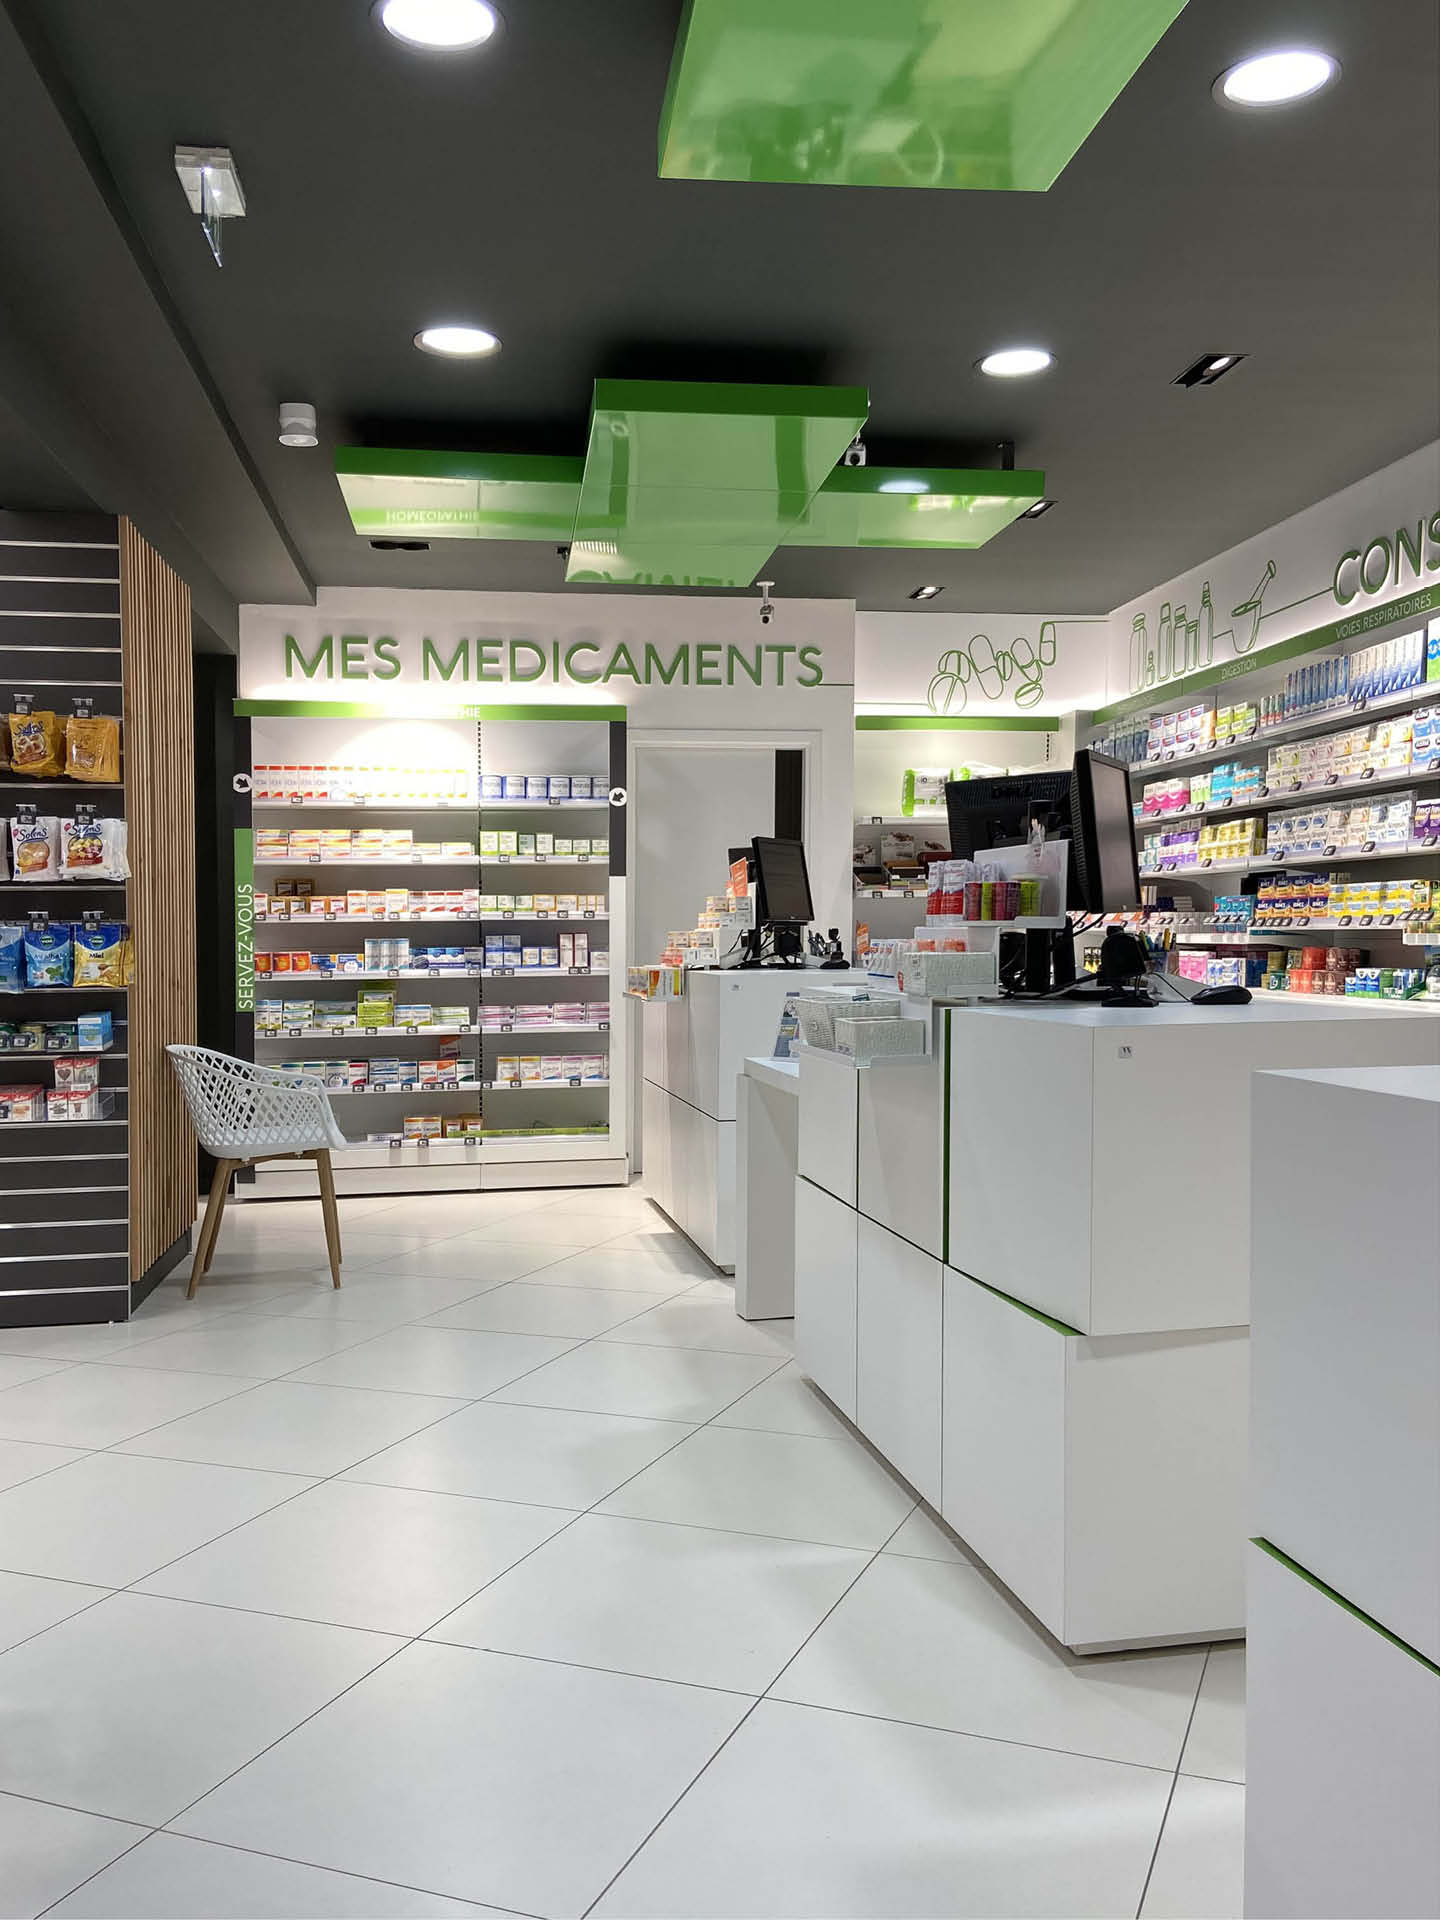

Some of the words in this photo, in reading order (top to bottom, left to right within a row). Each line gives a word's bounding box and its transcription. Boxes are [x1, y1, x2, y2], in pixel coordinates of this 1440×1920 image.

[1335, 615, 1361, 638] VOIES
[1363, 593, 1432, 630] RESPIRATOIRES
[285, 634, 401, 681] MES
[422, 638, 823, 688] MEDICAMENTS
[237, 883, 255, 1010] SERVEZ-VOUS
